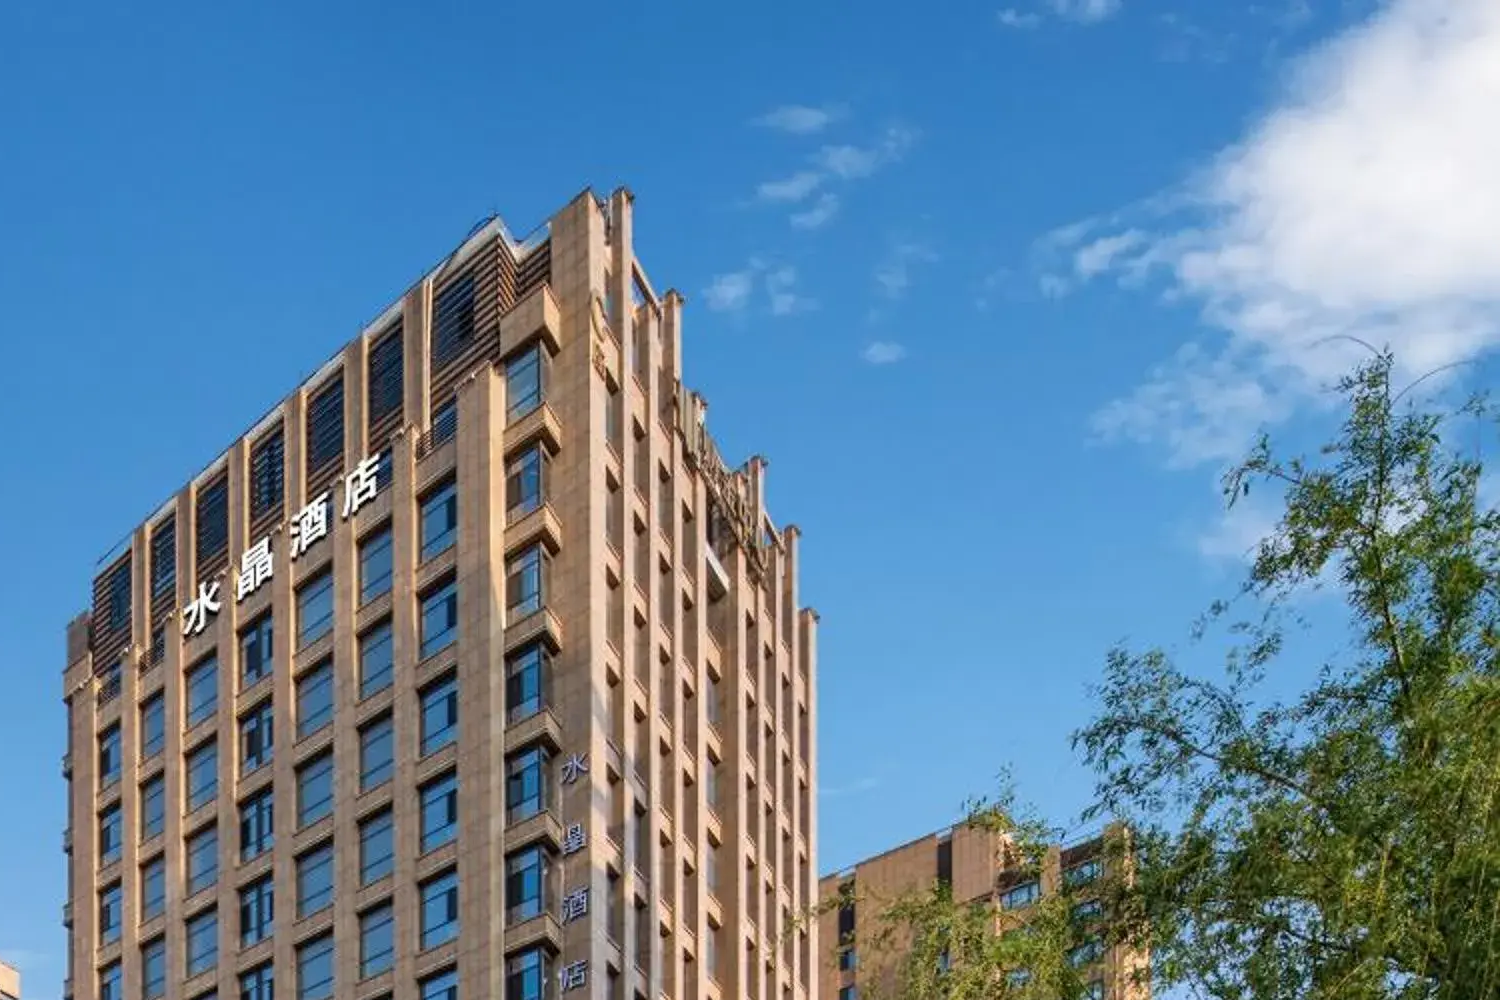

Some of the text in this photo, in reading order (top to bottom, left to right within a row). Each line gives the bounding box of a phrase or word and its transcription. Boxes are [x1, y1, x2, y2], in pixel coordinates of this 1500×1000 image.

[183, 453, 380, 636] 水晶酒店
[561, 752, 589, 993] 水晶酒店
